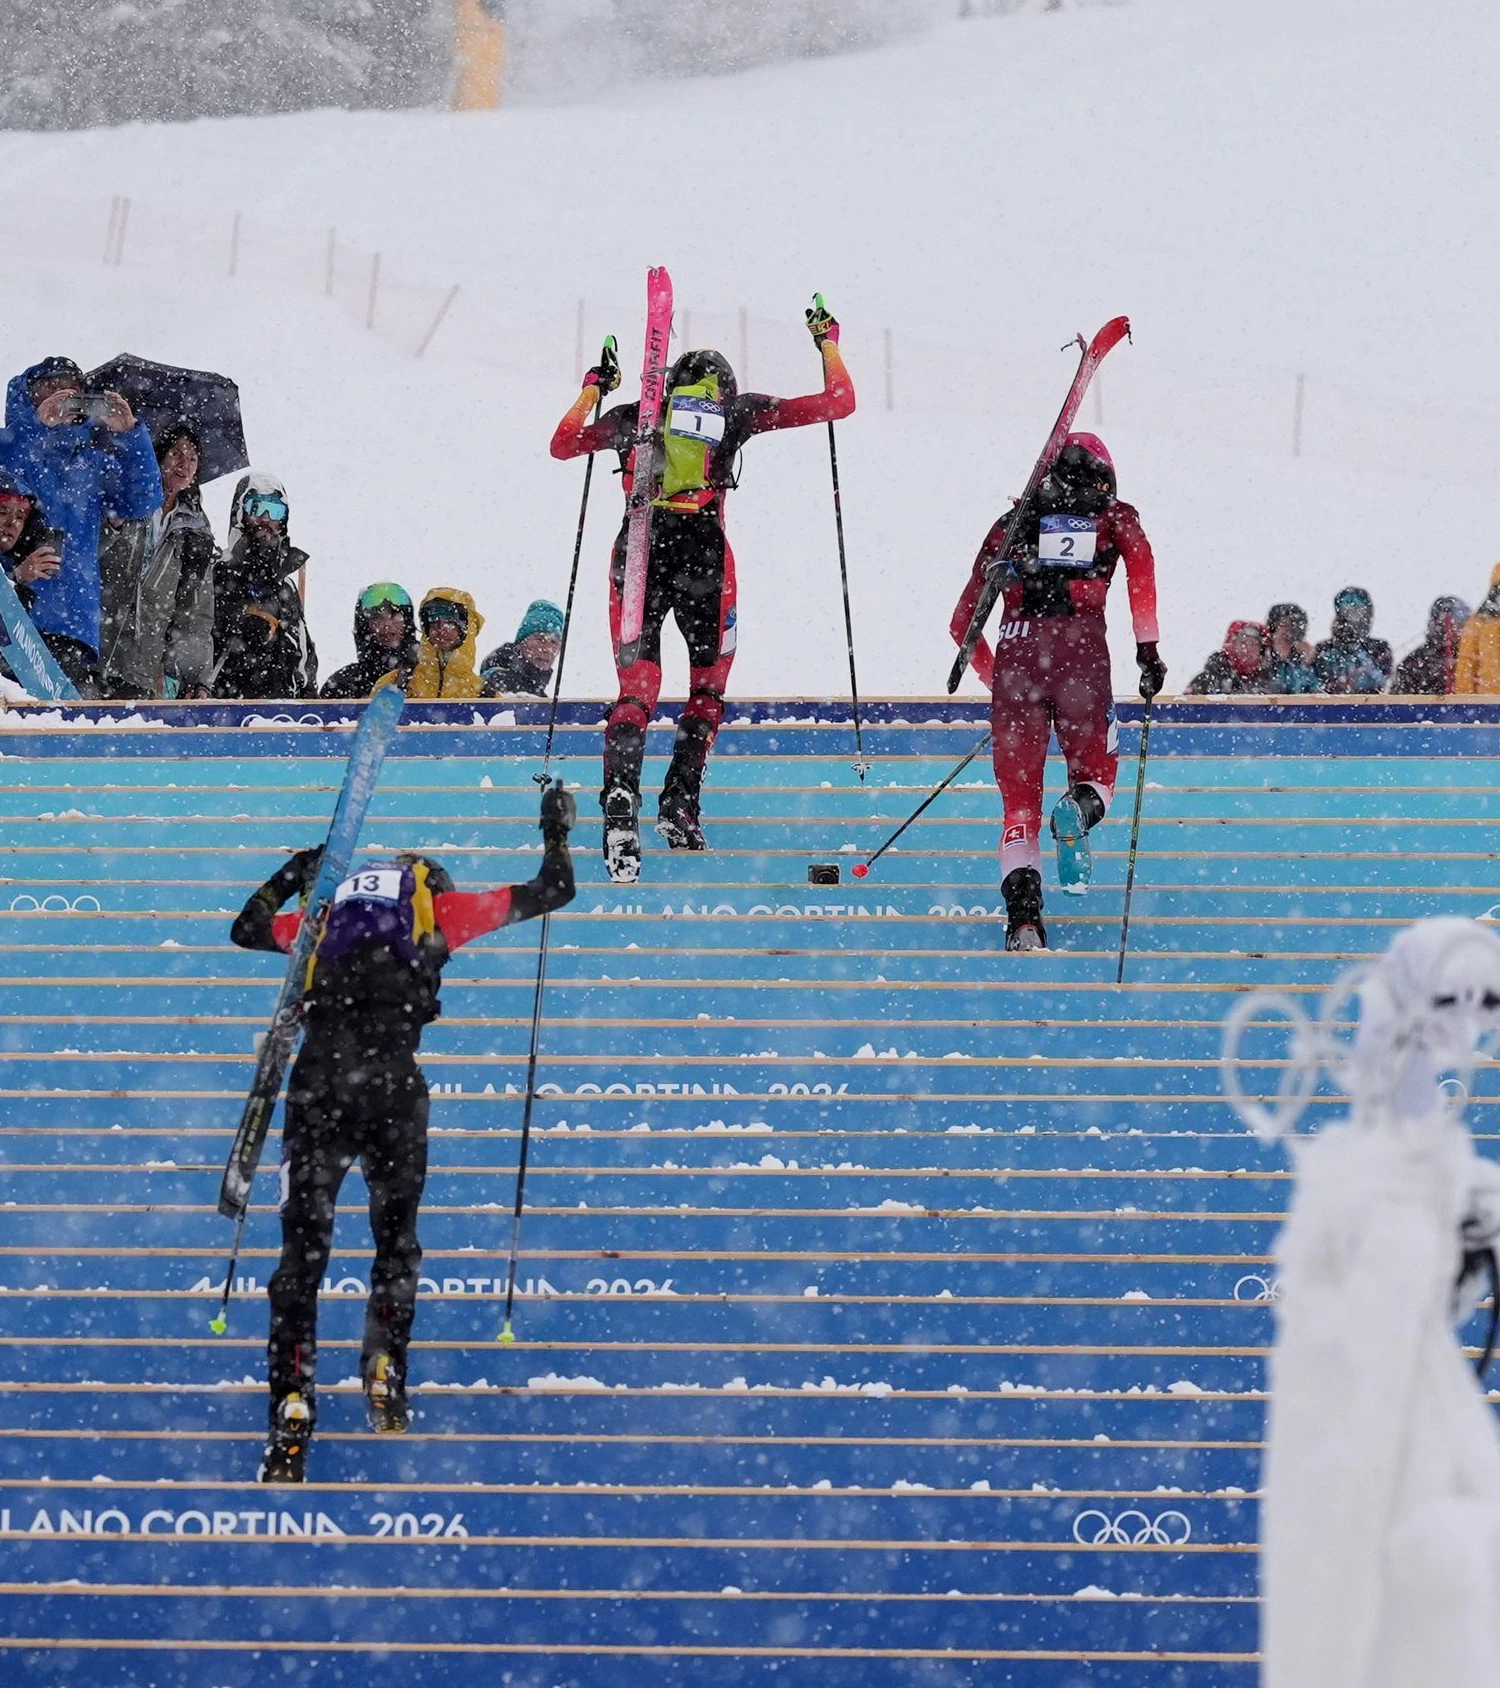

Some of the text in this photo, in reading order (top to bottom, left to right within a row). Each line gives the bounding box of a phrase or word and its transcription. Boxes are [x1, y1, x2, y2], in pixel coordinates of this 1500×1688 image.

[694, 415, 702, 432] 1
[1059, 537, 1075, 557] 2
[999, 620, 1030, 640] SUI
[352, 874, 380, 893] 13
[140, 1510, 348, 1537] CORTINA
[369, 1512, 469, 1538] 2026
